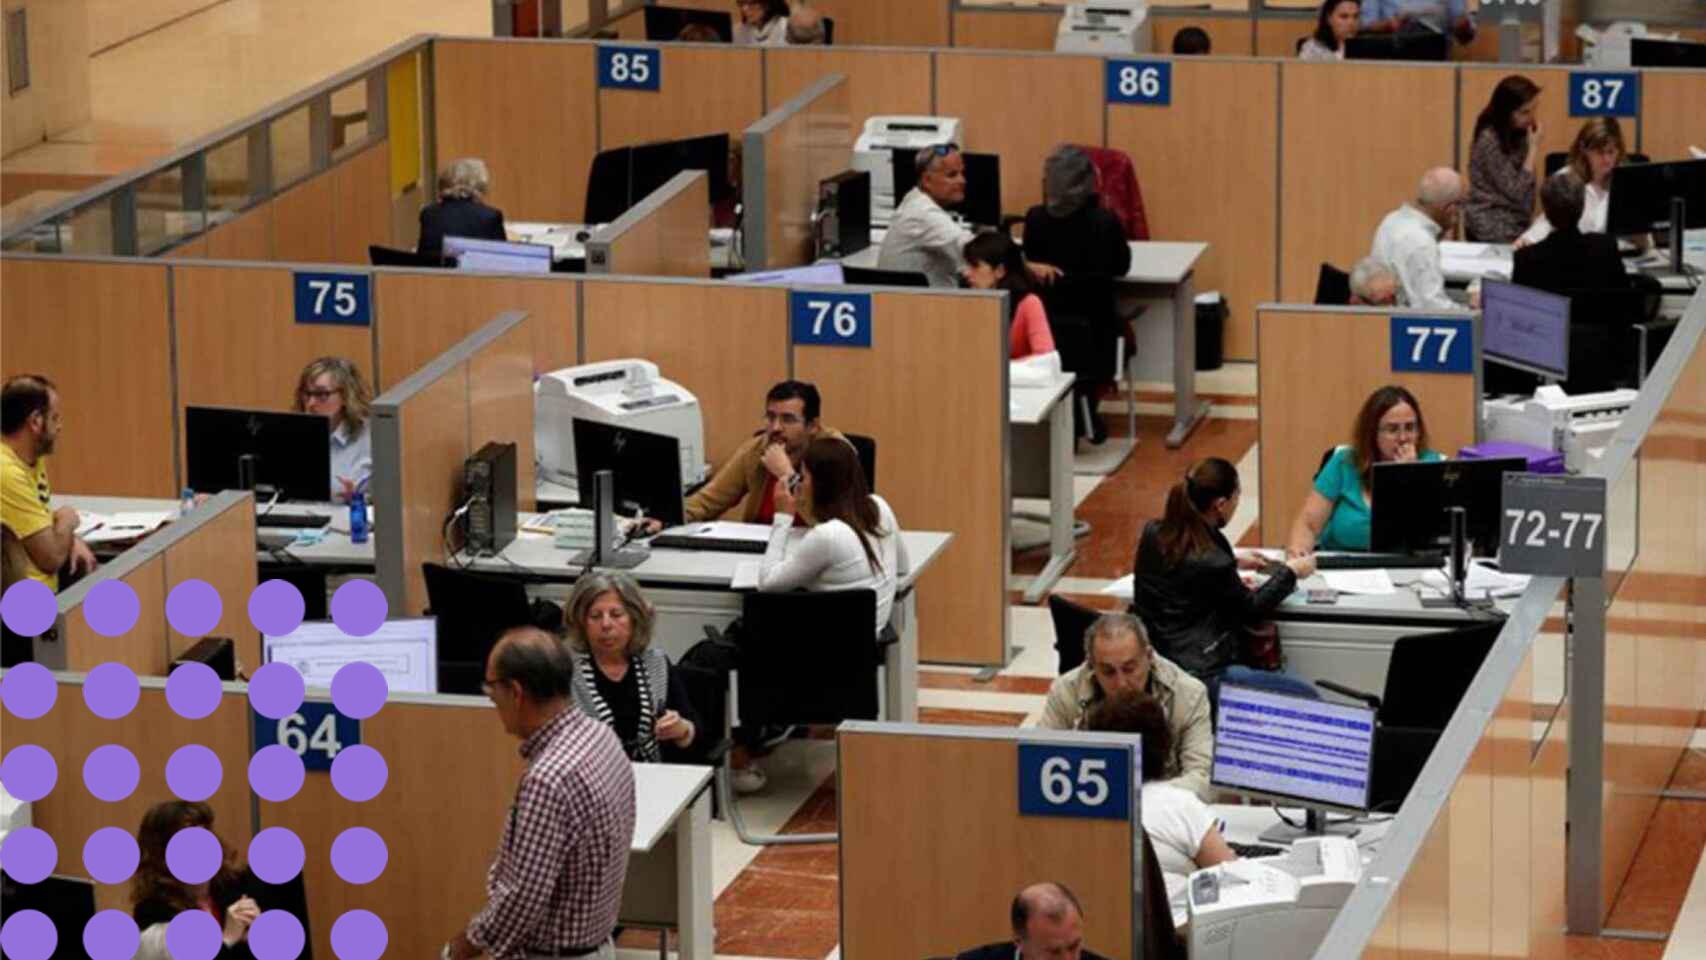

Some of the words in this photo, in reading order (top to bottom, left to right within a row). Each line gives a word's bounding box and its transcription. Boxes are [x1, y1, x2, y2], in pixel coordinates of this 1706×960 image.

[611, 53, 649, 82] 85
[1119, 67, 1159, 96] 86
[1582, 80, 1623, 109] 87
[309, 281, 356, 316] 75
[808, 301, 856, 337] 76
[1407, 327, 1457, 363] 77
[1505, 509, 1602, 550] 72-77
[277, 712, 342, 759] 64
[1041, 758, 1108, 805] 65
